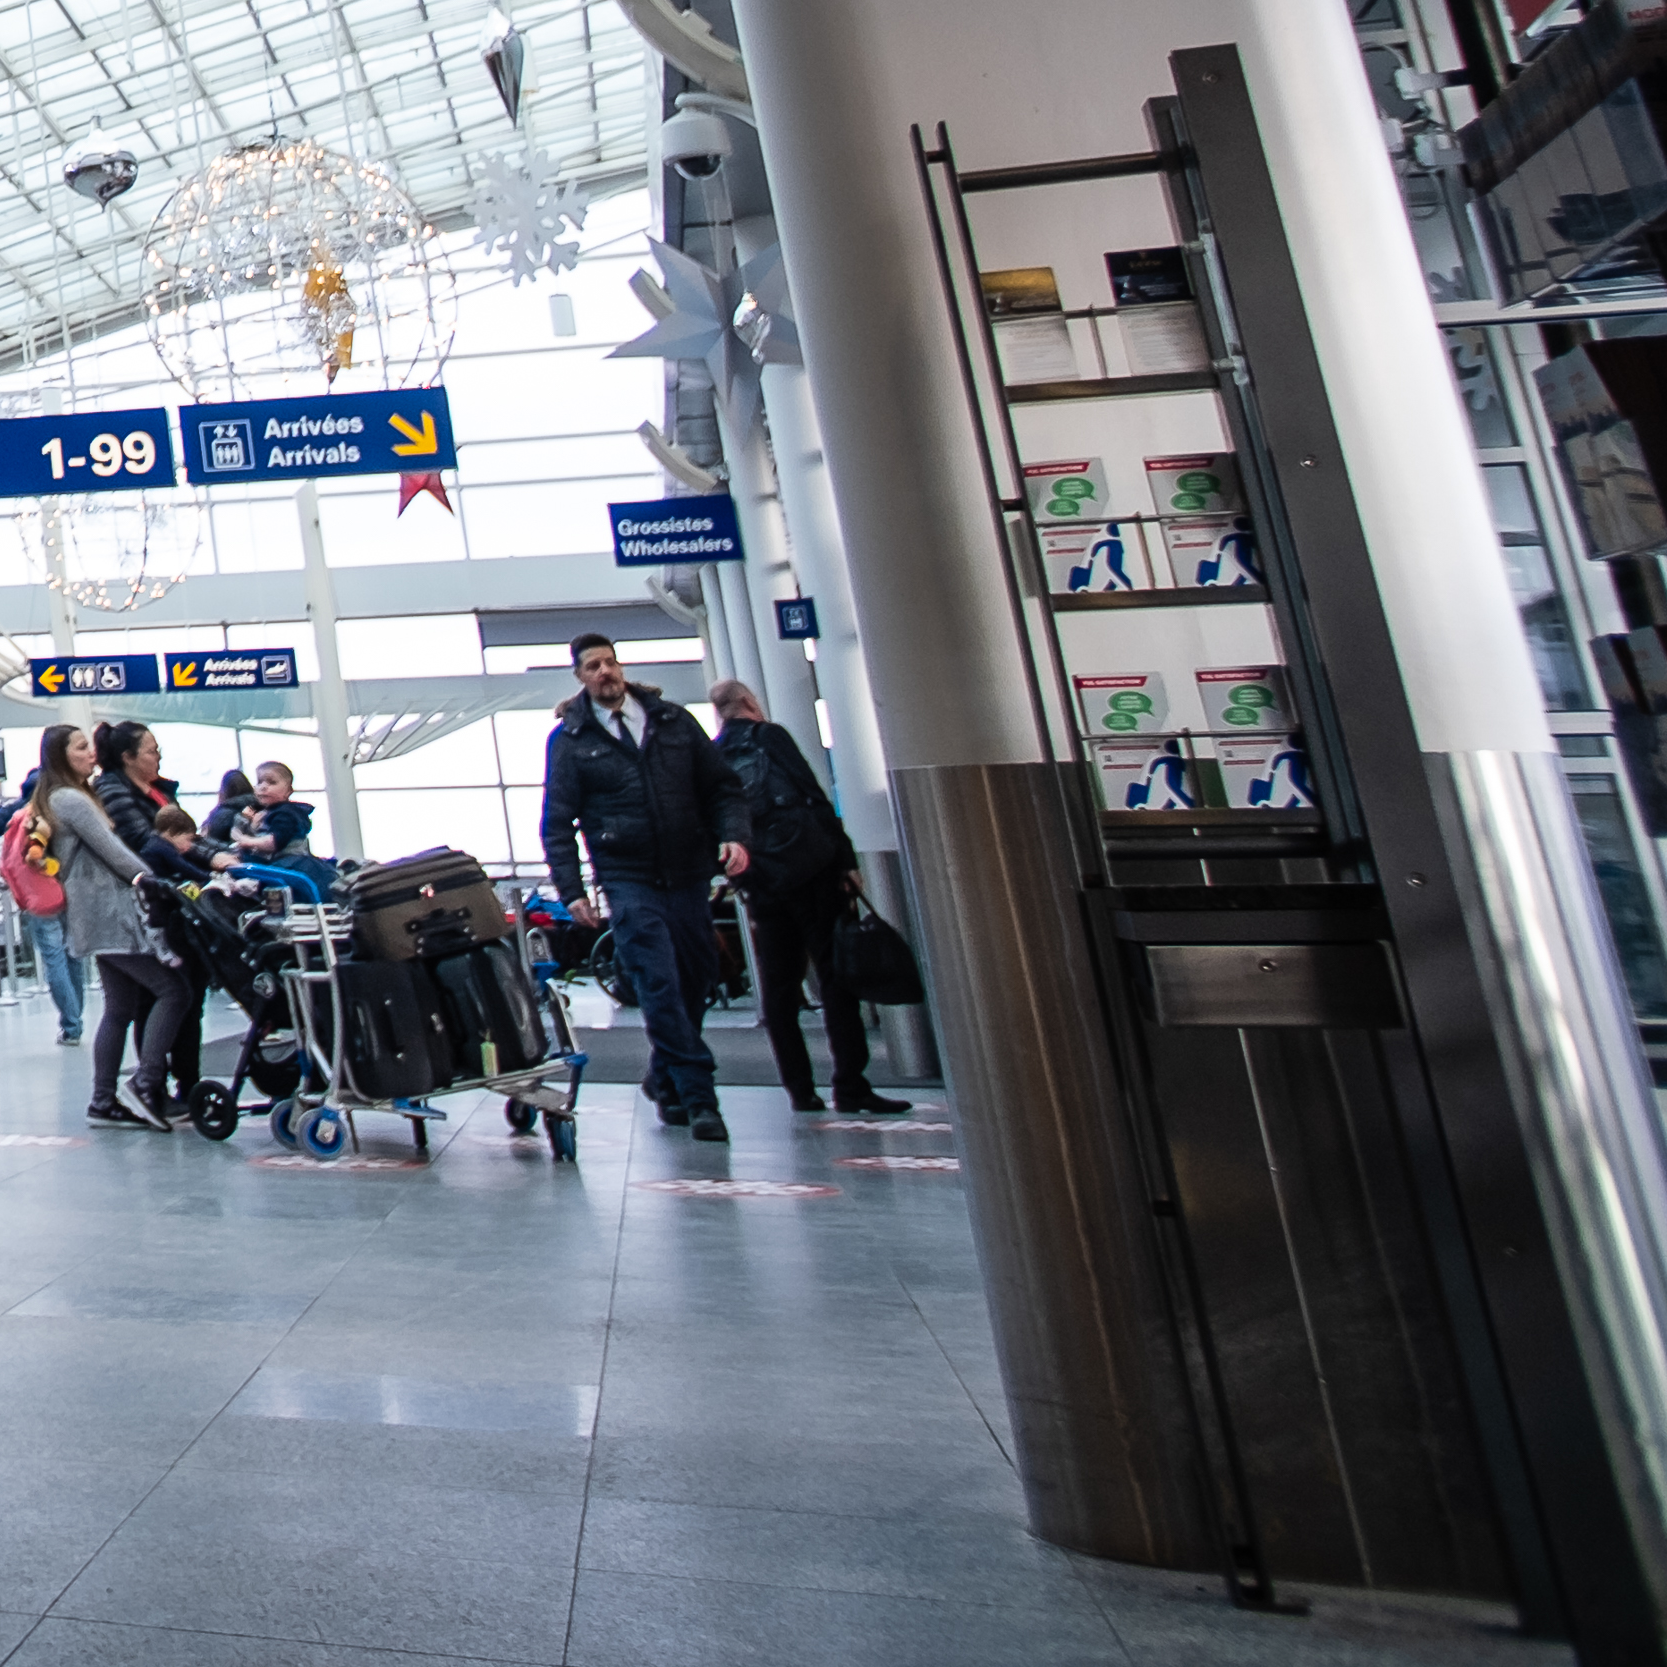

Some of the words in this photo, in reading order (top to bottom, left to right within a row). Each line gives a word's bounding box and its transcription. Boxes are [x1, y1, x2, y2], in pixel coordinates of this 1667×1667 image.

[265, 413, 364, 440] Arrivées
[40, 431, 157, 481] 1-99
[269, 441, 361, 468] Arrivals
[617, 516, 713, 536] Grossistes
[620, 535, 734, 557] Wholesalers
[203, 654, 258, 673] Arrivées
[204, 671, 256, 687] Arrivals
